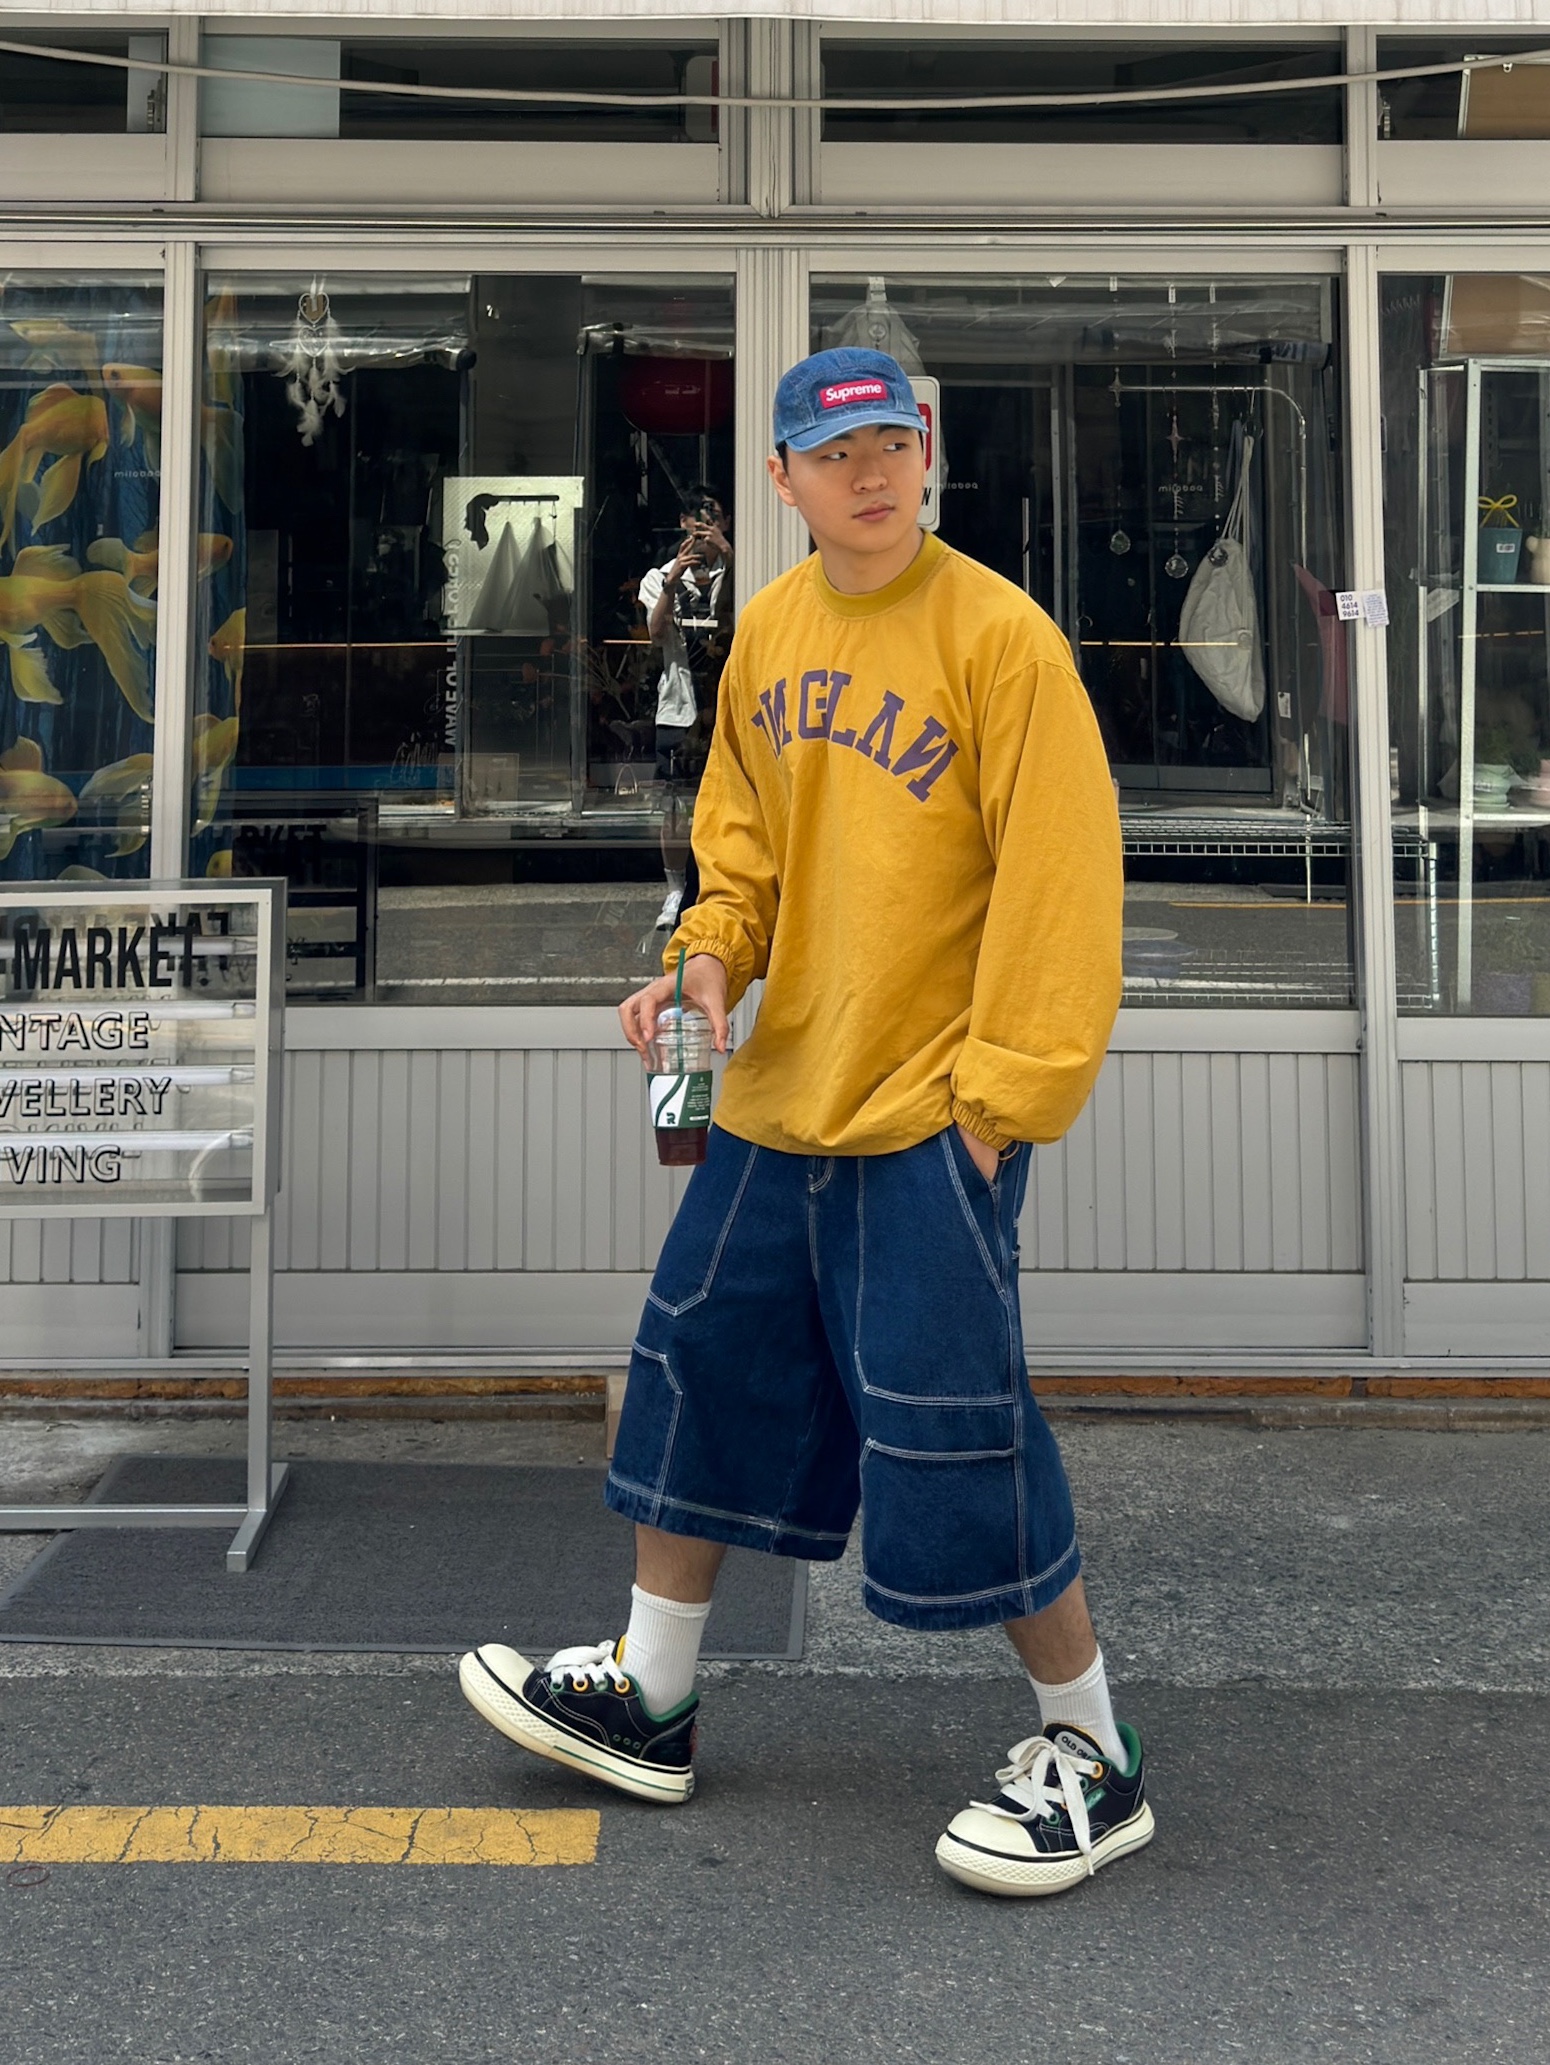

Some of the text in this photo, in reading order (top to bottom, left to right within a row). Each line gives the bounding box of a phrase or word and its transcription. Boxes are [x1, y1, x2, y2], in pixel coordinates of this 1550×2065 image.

[826, 383, 882, 401] Supreme
[1340, 594, 1353, 602] 010
[1342, 602, 1358, 610] 4614
[13, 926, 201, 990] MARKET
[0, 1012, 149, 1051] NTAGE
[4, 1144, 121, 1184] VING
[1061, 1736, 1077, 1750] OLD
